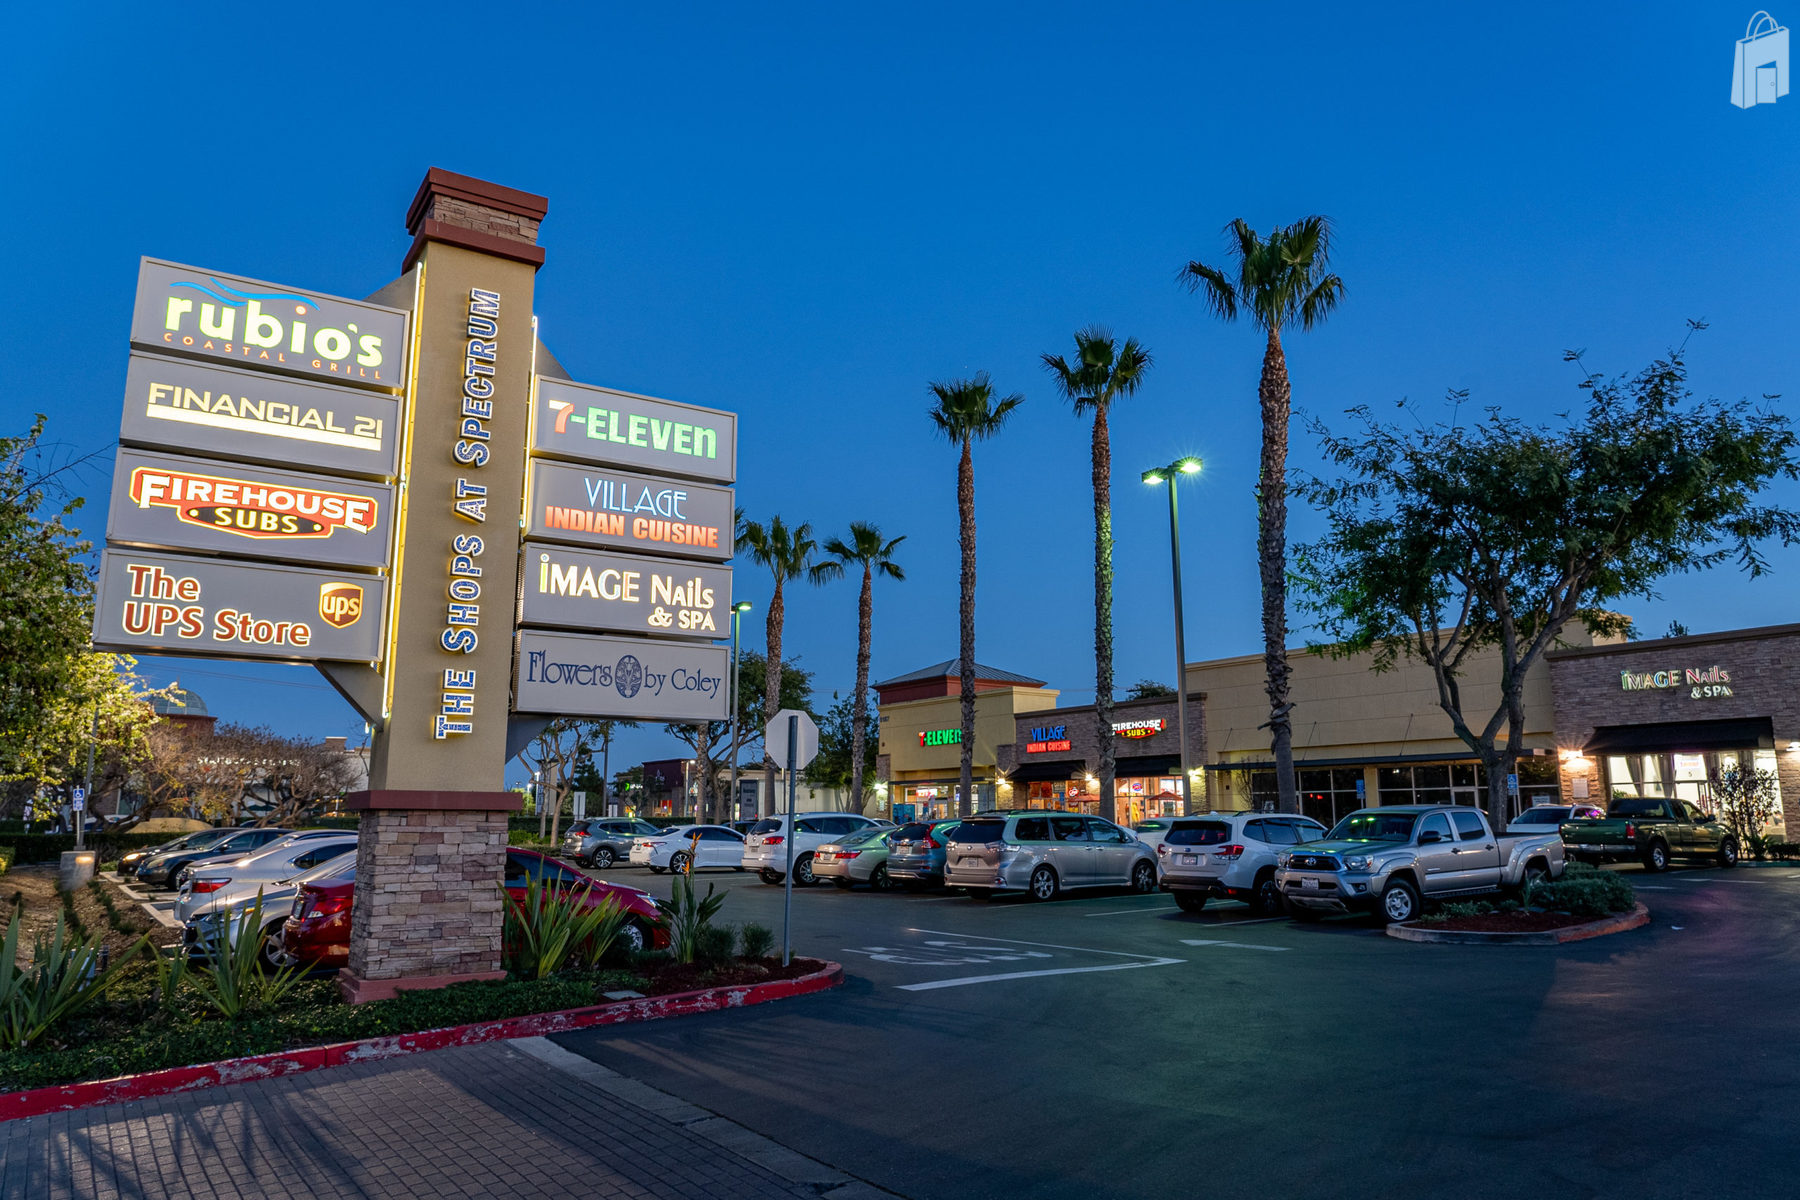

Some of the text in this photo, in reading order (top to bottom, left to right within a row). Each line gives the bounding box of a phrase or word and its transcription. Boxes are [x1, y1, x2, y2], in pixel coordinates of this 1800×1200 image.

[164, 296, 383, 368] rubio's
[163, 332, 381, 380] COASTAL GRILL
[148, 382, 383, 439] FINANCIAL 21
[139, 473, 370, 535] FIREHOUSE
[434, 287, 500, 740] THE SHOPS AT SPECTRUM
[584, 477, 687, 520] VILLAGE
[214, 506, 299, 534] SUBS
[545, 506, 719, 548] INDIAN CUISINE
[127, 563, 201, 601] The
[122, 601, 312, 647] UPS Store
[322, 594, 360, 621] ups
[647, 606, 716, 632] & SPA
[527, 649, 721, 699] Flowers by Coley
[1690, 685, 1733, 699] & SPA
[1031, 725, 1066, 742] VILLAGE
[1126, 728, 1146, 737] SUBS
